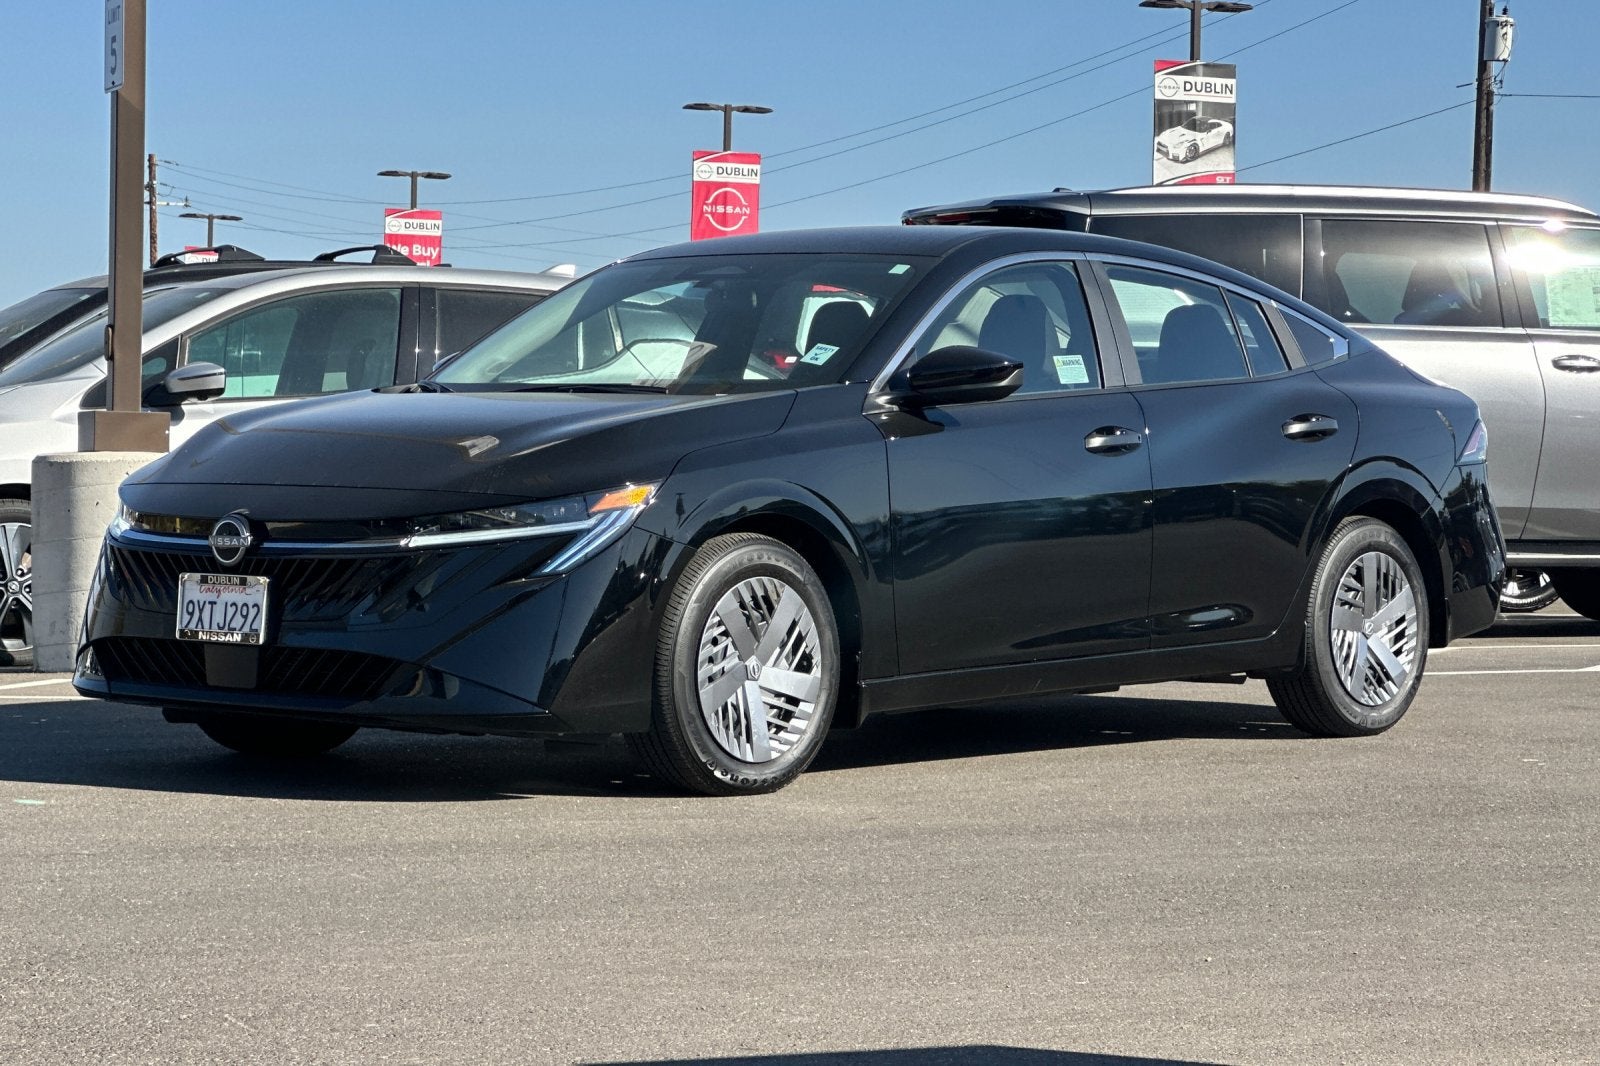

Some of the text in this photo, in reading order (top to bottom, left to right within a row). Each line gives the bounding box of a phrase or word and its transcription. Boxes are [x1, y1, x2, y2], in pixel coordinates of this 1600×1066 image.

[110, 35, 117, 75] 5
[1183, 81, 1234, 95] DUBLIN
[716, 166, 758, 177] DUBLIN
[702, 204, 750, 214] NISSAN
[404, 221, 440, 231] DUBLIN
[412, 243, 440, 260] Buy
[815, 345, 835, 353] SAFETY
[209, 536, 248, 546] NISSAN
[207, 575, 240, 585] DUBLIN
[184, 599, 261, 633] 9XTJ292
[198, 631, 242, 642] NISSAN
